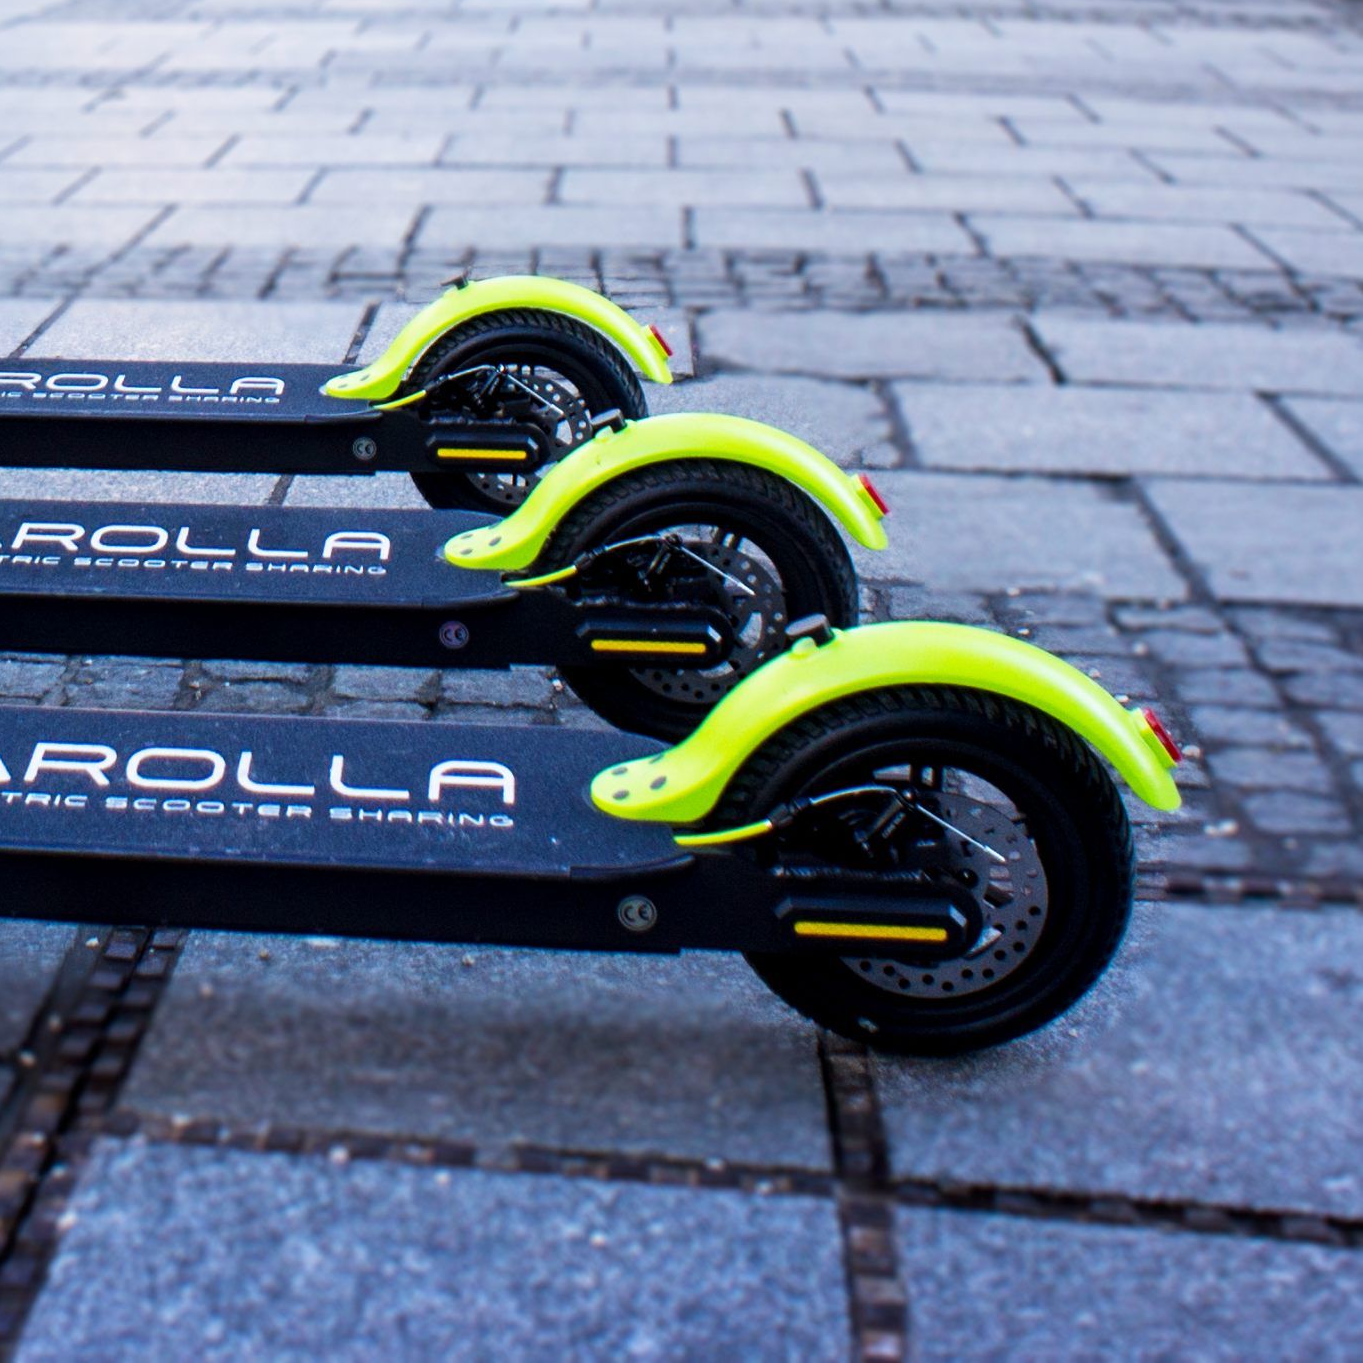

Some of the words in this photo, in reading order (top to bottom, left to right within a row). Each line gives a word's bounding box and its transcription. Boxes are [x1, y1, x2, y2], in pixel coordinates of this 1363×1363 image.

[32, 392, 160, 401] SCOOTER
[167, 395, 280, 404] SHARING
[73, 556, 234, 571] SCOOTER
[245, 561, 388, 576] SHARING
[104, 795, 313, 819] SCOOTER
[329, 806, 515, 828] SHARING
